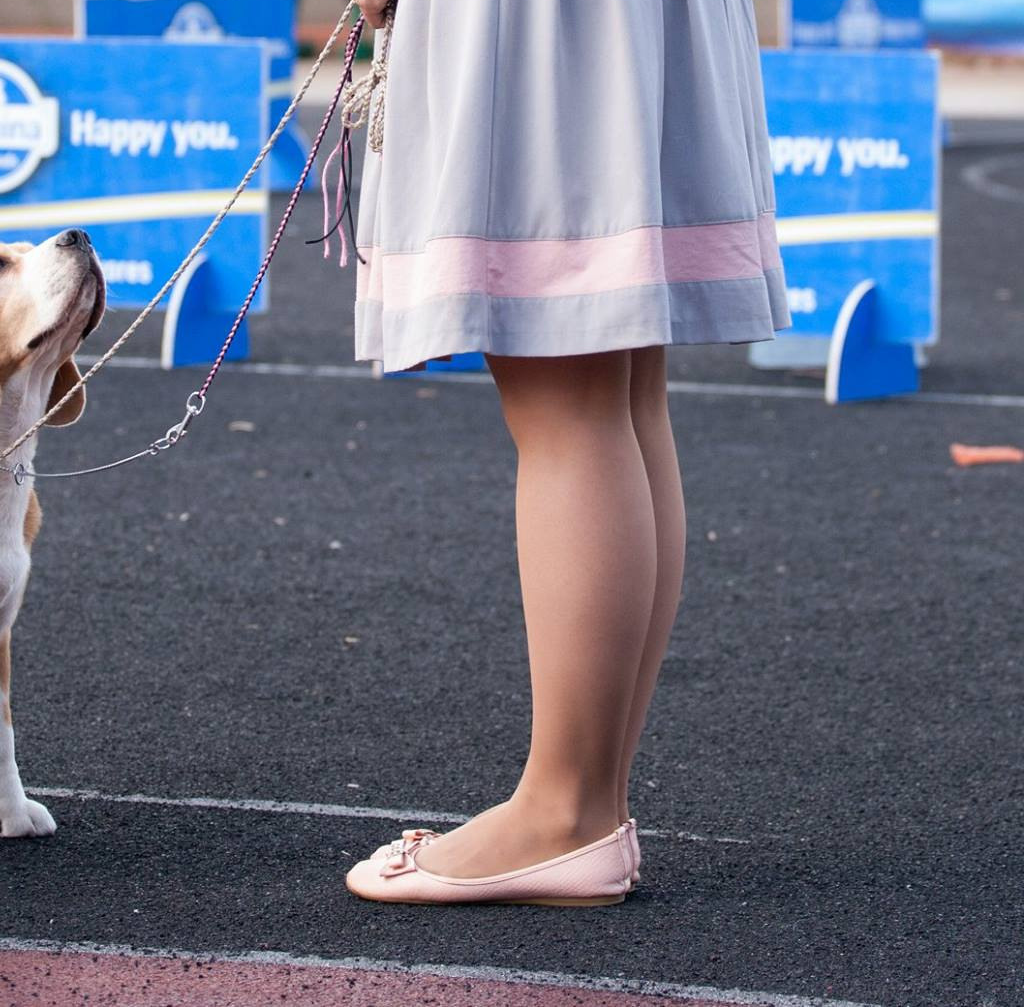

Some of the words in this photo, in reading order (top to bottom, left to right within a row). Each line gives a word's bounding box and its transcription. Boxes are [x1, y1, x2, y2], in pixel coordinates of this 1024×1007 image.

[70, 109, 167, 157] Happy
[171, 120, 239, 157] you.
[769, 136, 833, 175] ppy
[837, 138, 909, 176] you.
